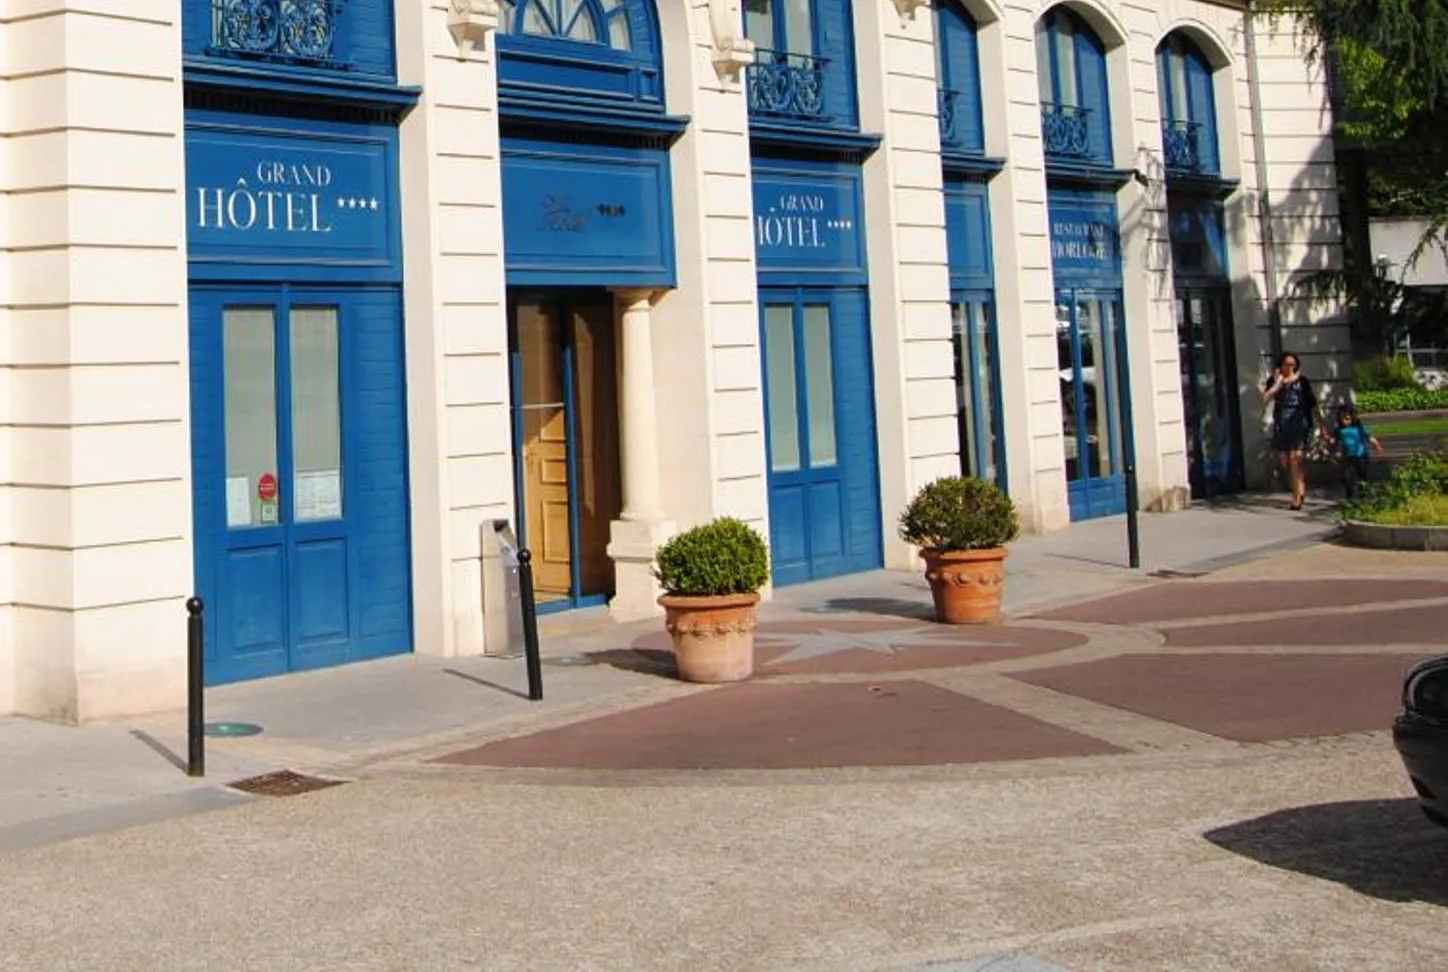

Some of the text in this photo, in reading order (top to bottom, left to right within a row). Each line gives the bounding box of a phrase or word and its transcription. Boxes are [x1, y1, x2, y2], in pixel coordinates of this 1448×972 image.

[256, 160, 331, 186] GRAND
[196, 177, 332, 232] HÔTEL
[779, 194, 824, 213] GRAND
